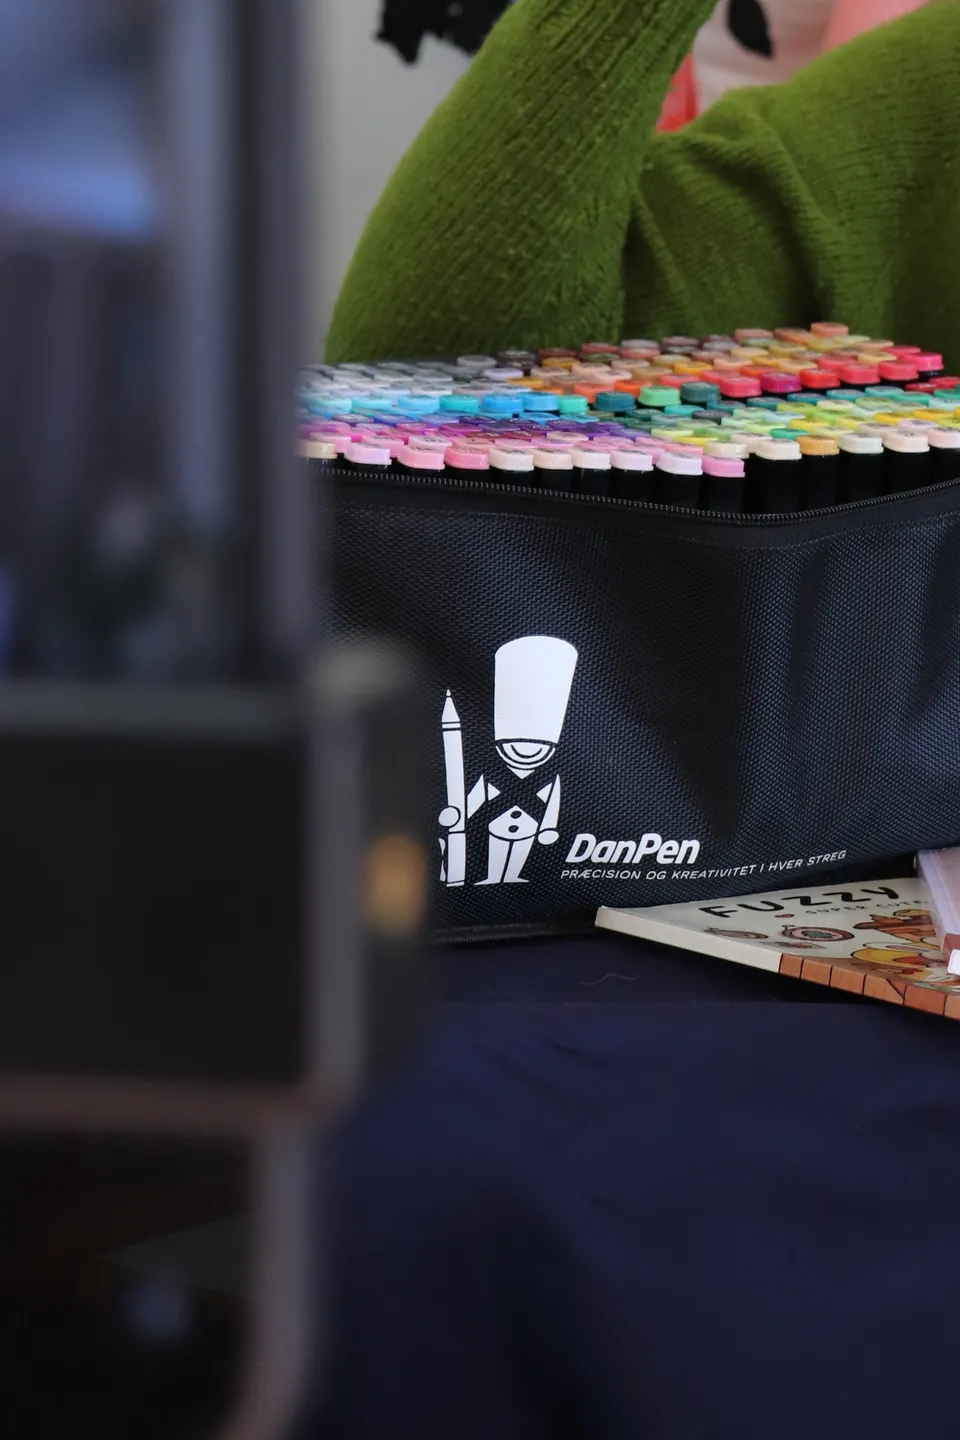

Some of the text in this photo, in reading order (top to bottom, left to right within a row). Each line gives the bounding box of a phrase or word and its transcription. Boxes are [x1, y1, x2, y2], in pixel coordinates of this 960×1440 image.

[565, 832, 701, 865] DanPen
[560, 850, 847, 880] PRÆCISION OG KREATIVITET I HVER STREG
[698, 886, 899, 918] FUZZY
